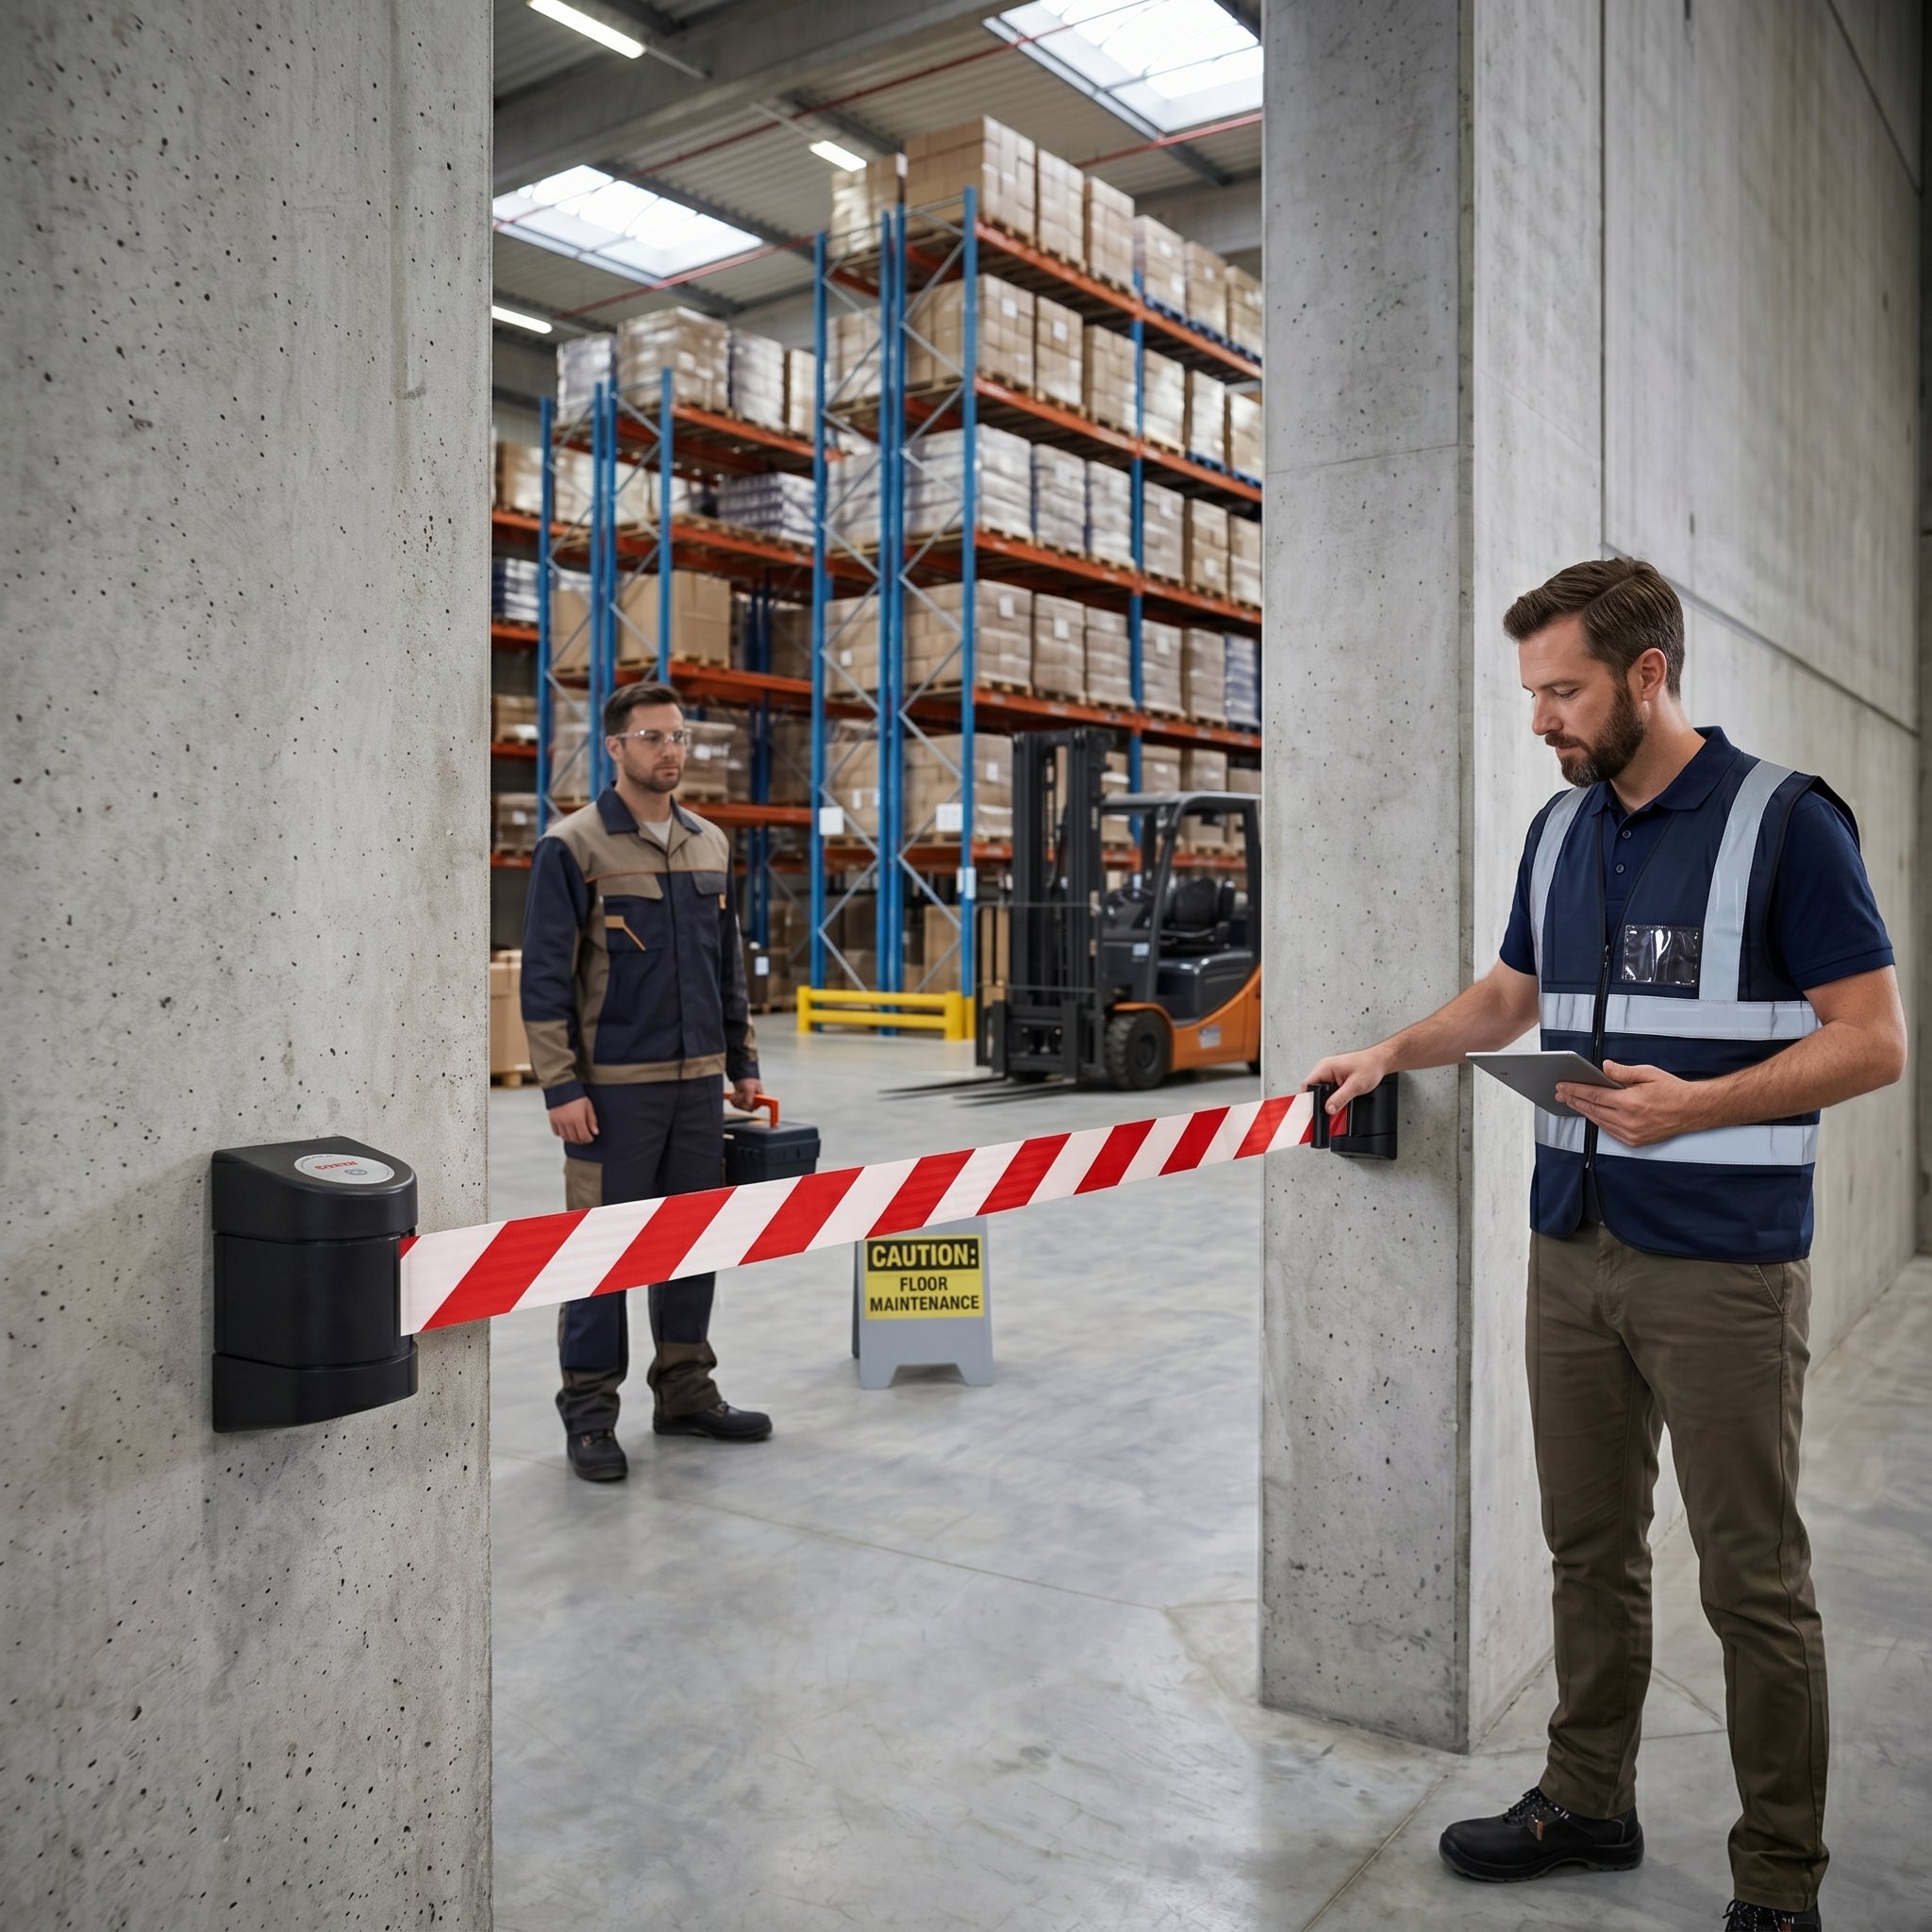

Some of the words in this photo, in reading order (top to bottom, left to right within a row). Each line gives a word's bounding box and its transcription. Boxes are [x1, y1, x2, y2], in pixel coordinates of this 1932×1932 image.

[872, 1243, 976, 1267] CAUTION:
[900, 1276, 948, 1291] FLOOR
[870, 1295, 979, 1311] MAINTENANCE
